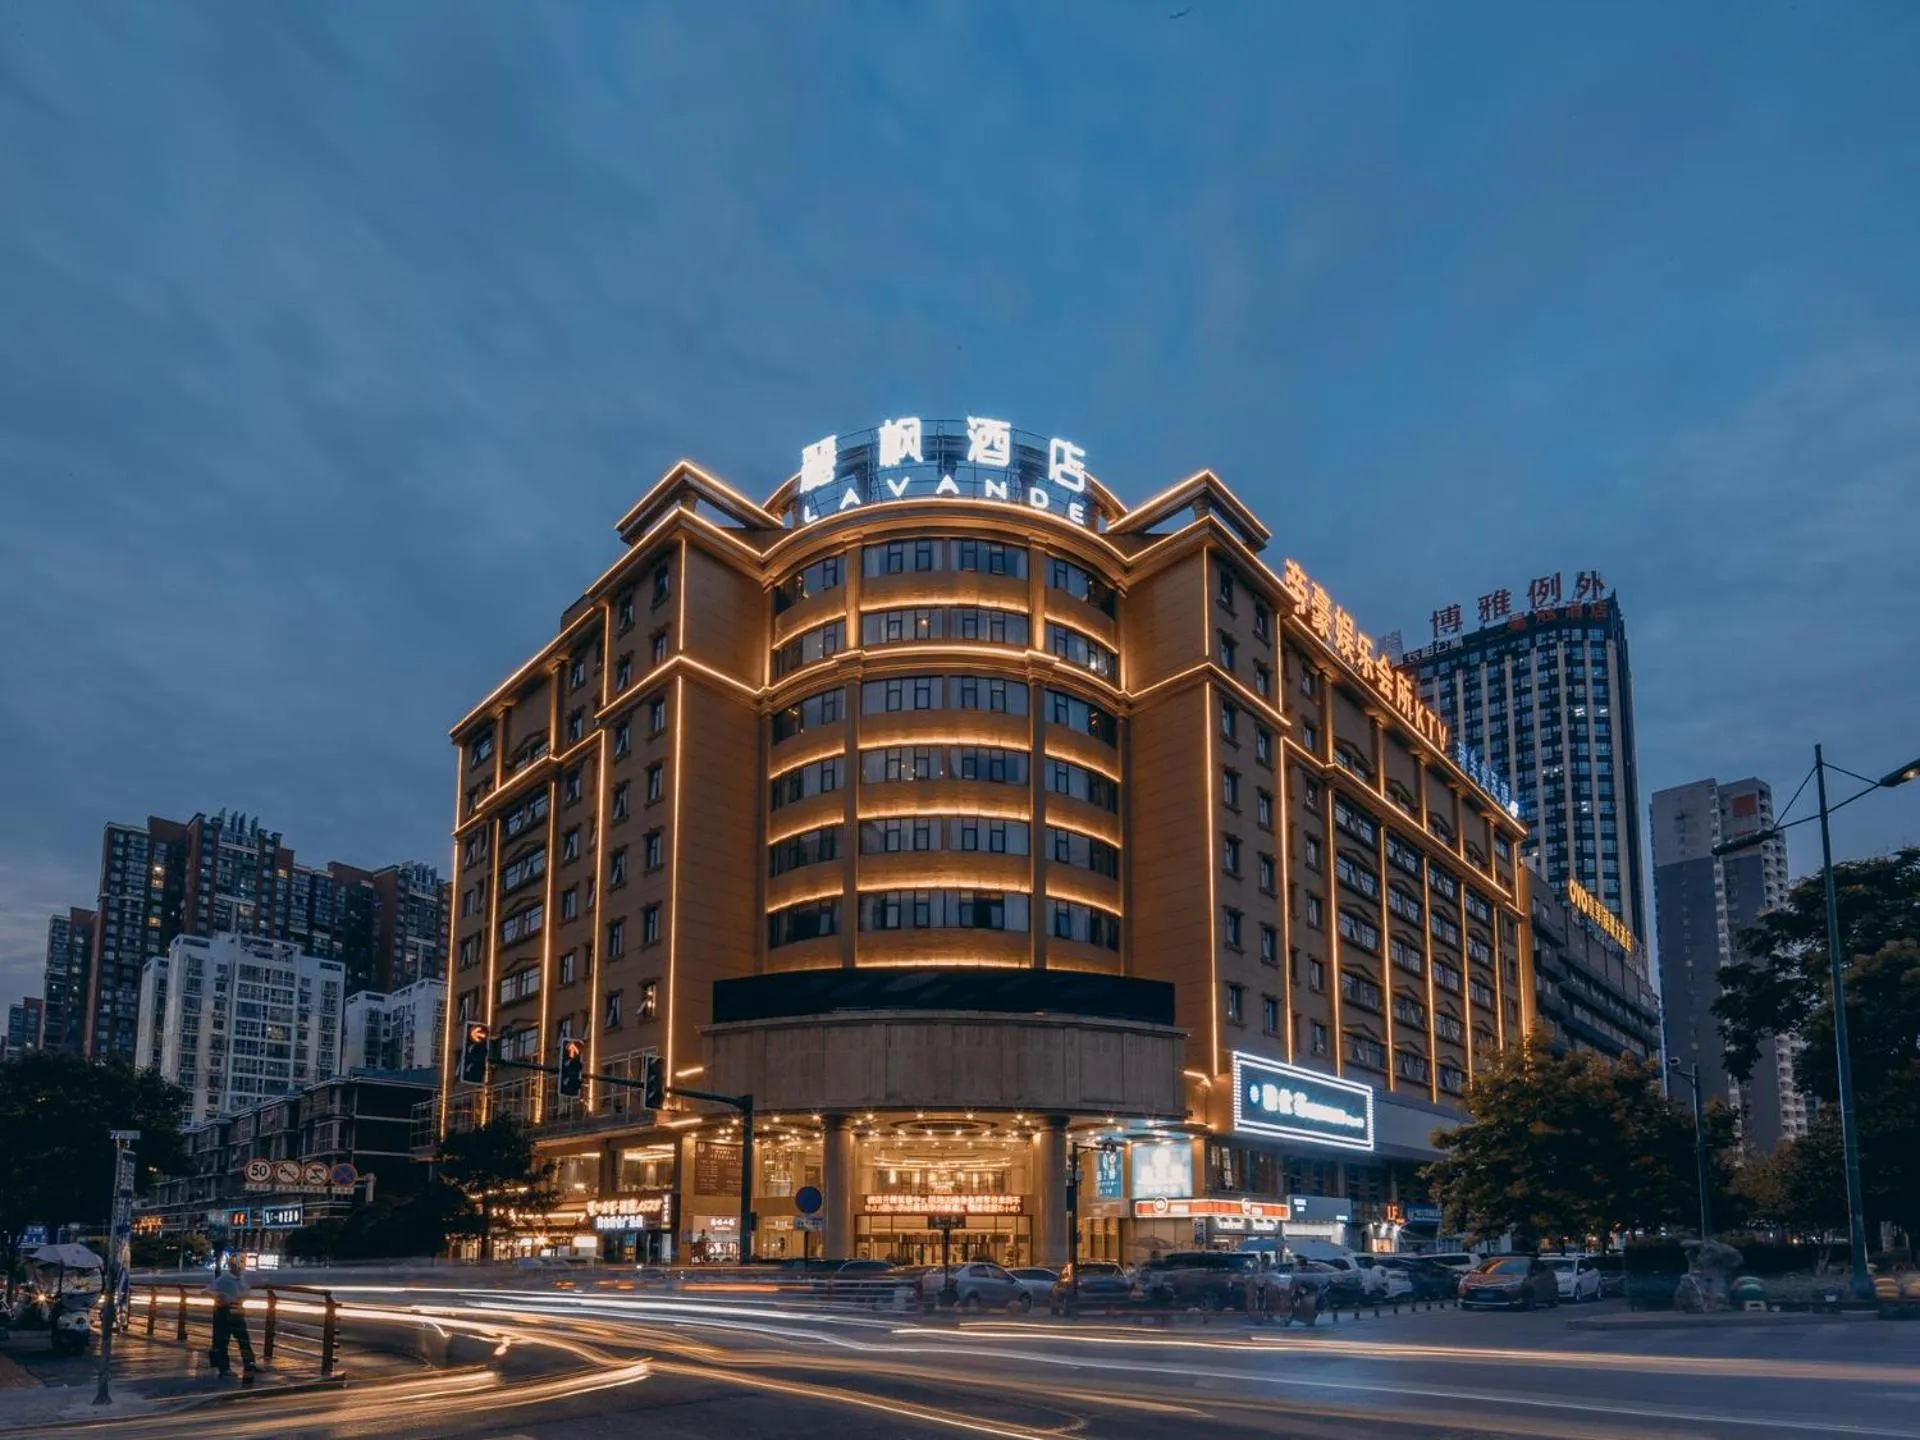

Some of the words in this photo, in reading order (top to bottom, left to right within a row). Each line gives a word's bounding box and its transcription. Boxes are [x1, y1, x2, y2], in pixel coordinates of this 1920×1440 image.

[804, 474, 1085, 525] LAVANDE
[1430, 570, 1607, 636] 博雅例外
[251, 1164, 267, 1177] 50
